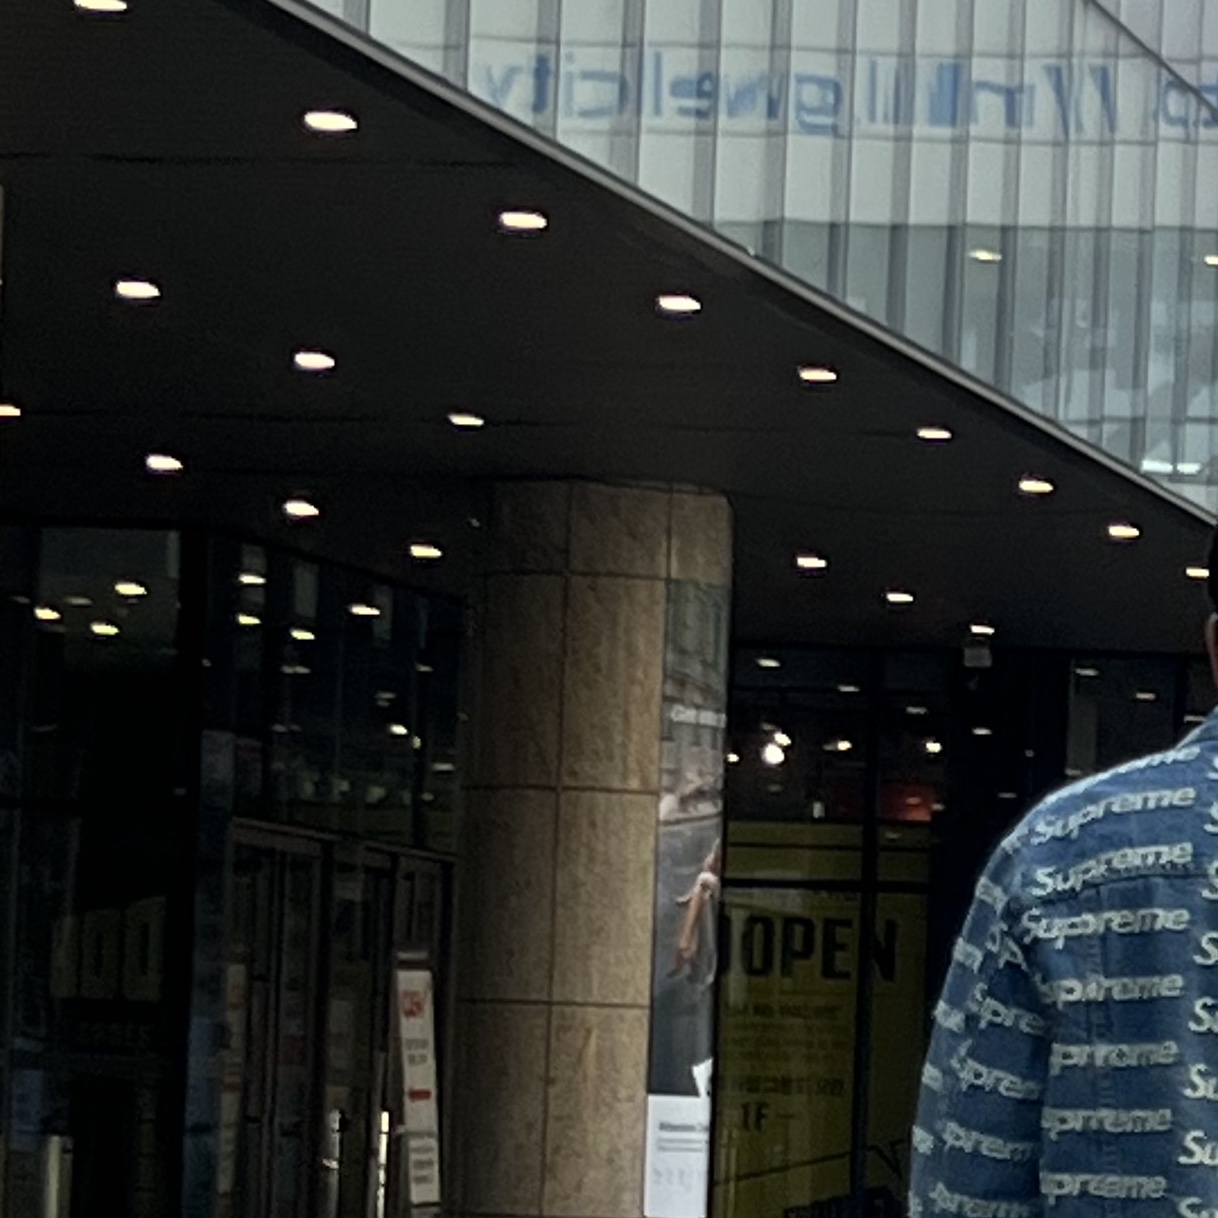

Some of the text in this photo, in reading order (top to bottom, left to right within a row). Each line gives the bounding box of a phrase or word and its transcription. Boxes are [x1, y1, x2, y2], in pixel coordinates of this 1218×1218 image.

[1030, 787, 1196, 846] Supreme
[1032, 842, 1194, 896] Supreme
[718, 915, 897, 982] OPEN
[1021, 906, 1191, 950] Supreme
[1034, 973, 1185, 1011] preme
[1048, 1040, 1179, 1078] preme
[1041, 1107, 1173, 1142] preme
[1040, 1171, 1168, 1206] preme
